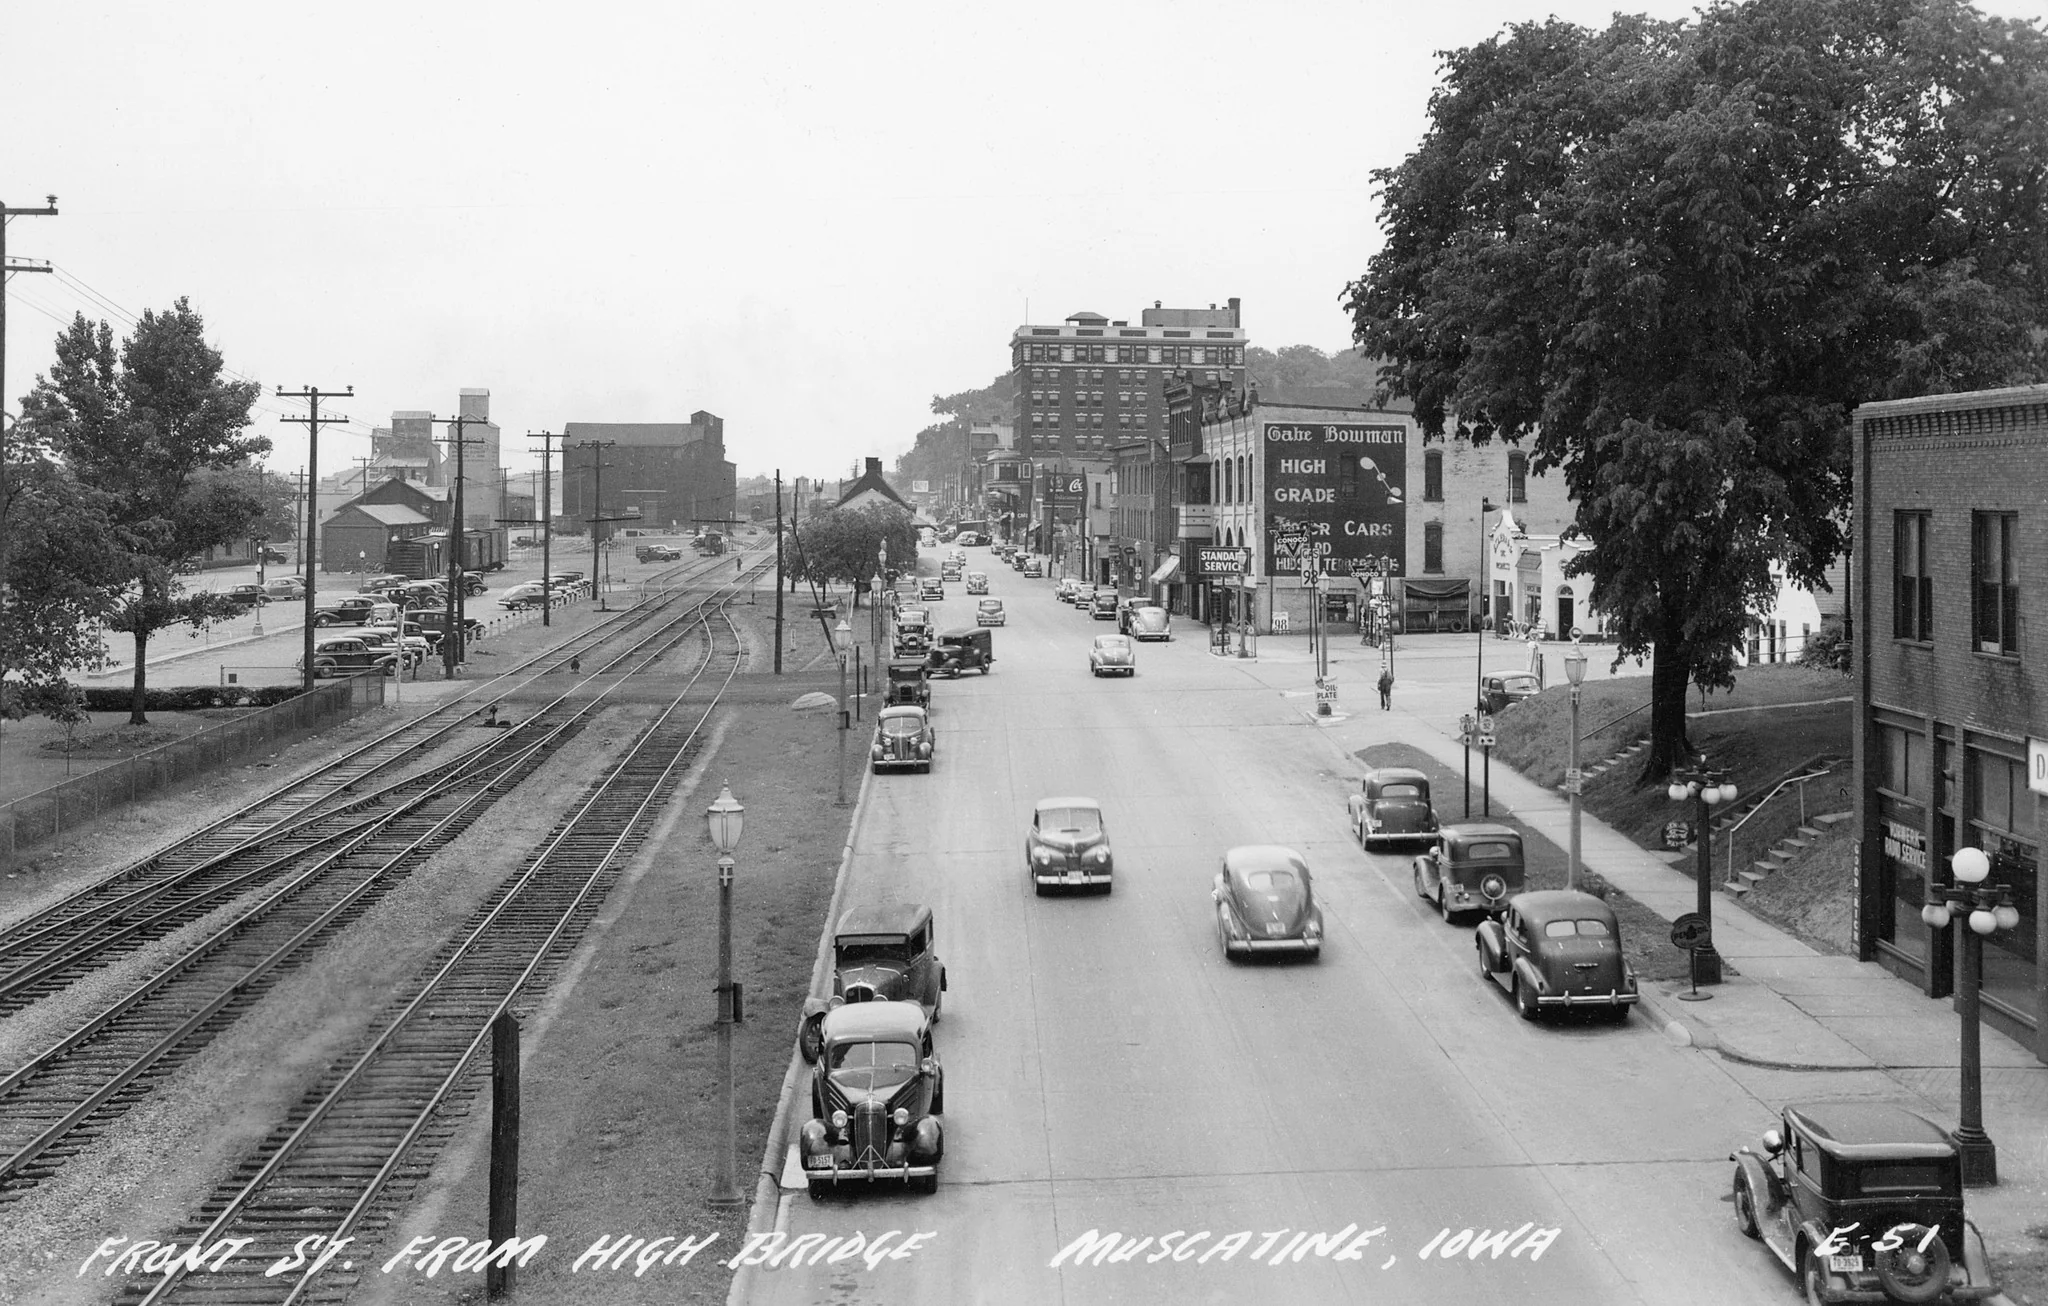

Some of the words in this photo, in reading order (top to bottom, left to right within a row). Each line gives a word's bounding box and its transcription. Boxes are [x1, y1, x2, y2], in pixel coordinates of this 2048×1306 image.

[1267, 426, 1313, 442] Gabe
[1323, 426, 1404, 444] Bowman
[1280, 459, 1326, 474] HIGH
[1274, 488, 1336, 503] GRADE
[1344, 520, 1393, 536] CARS
[1277, 536, 1308, 544] CONOCO
[1302, 570, 1319, 585] 98
[1316, 691, 1337, 699] PLATE
[1902, 843, 1926, 869] SERVICE
